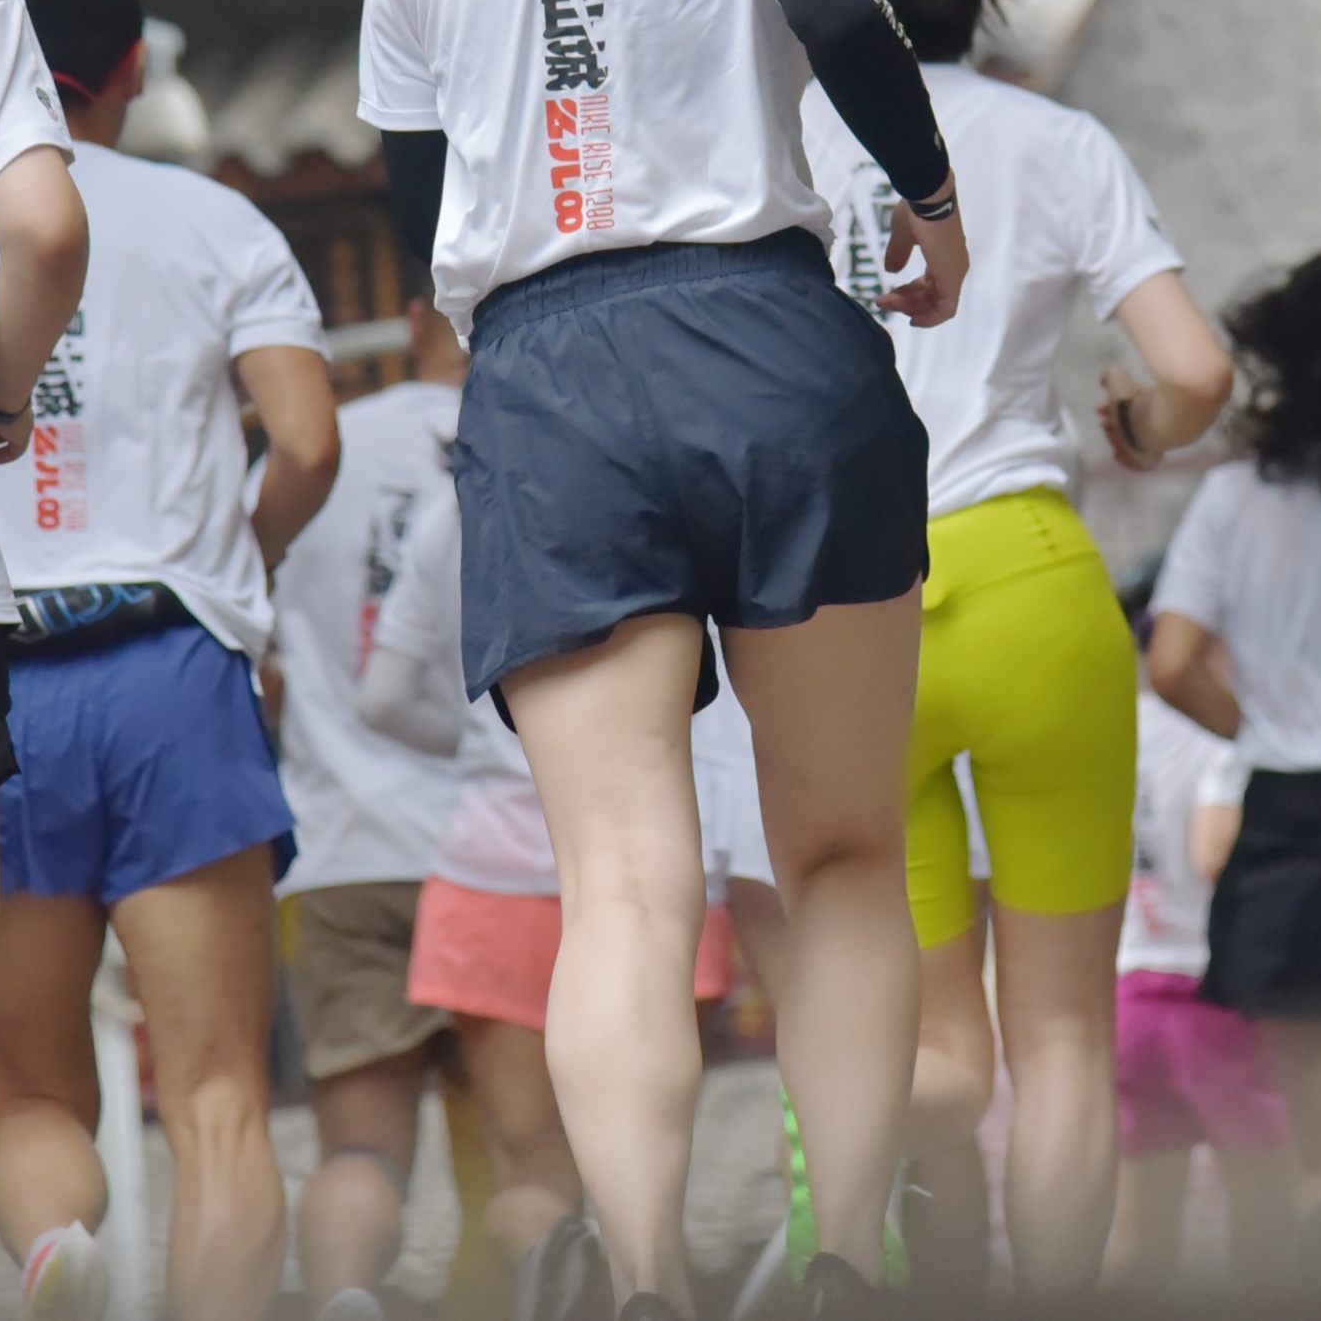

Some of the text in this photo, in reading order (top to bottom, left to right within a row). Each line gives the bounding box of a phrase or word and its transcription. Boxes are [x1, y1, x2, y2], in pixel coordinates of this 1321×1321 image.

[579, 94, 616, 231] NIKE RISE 1200
